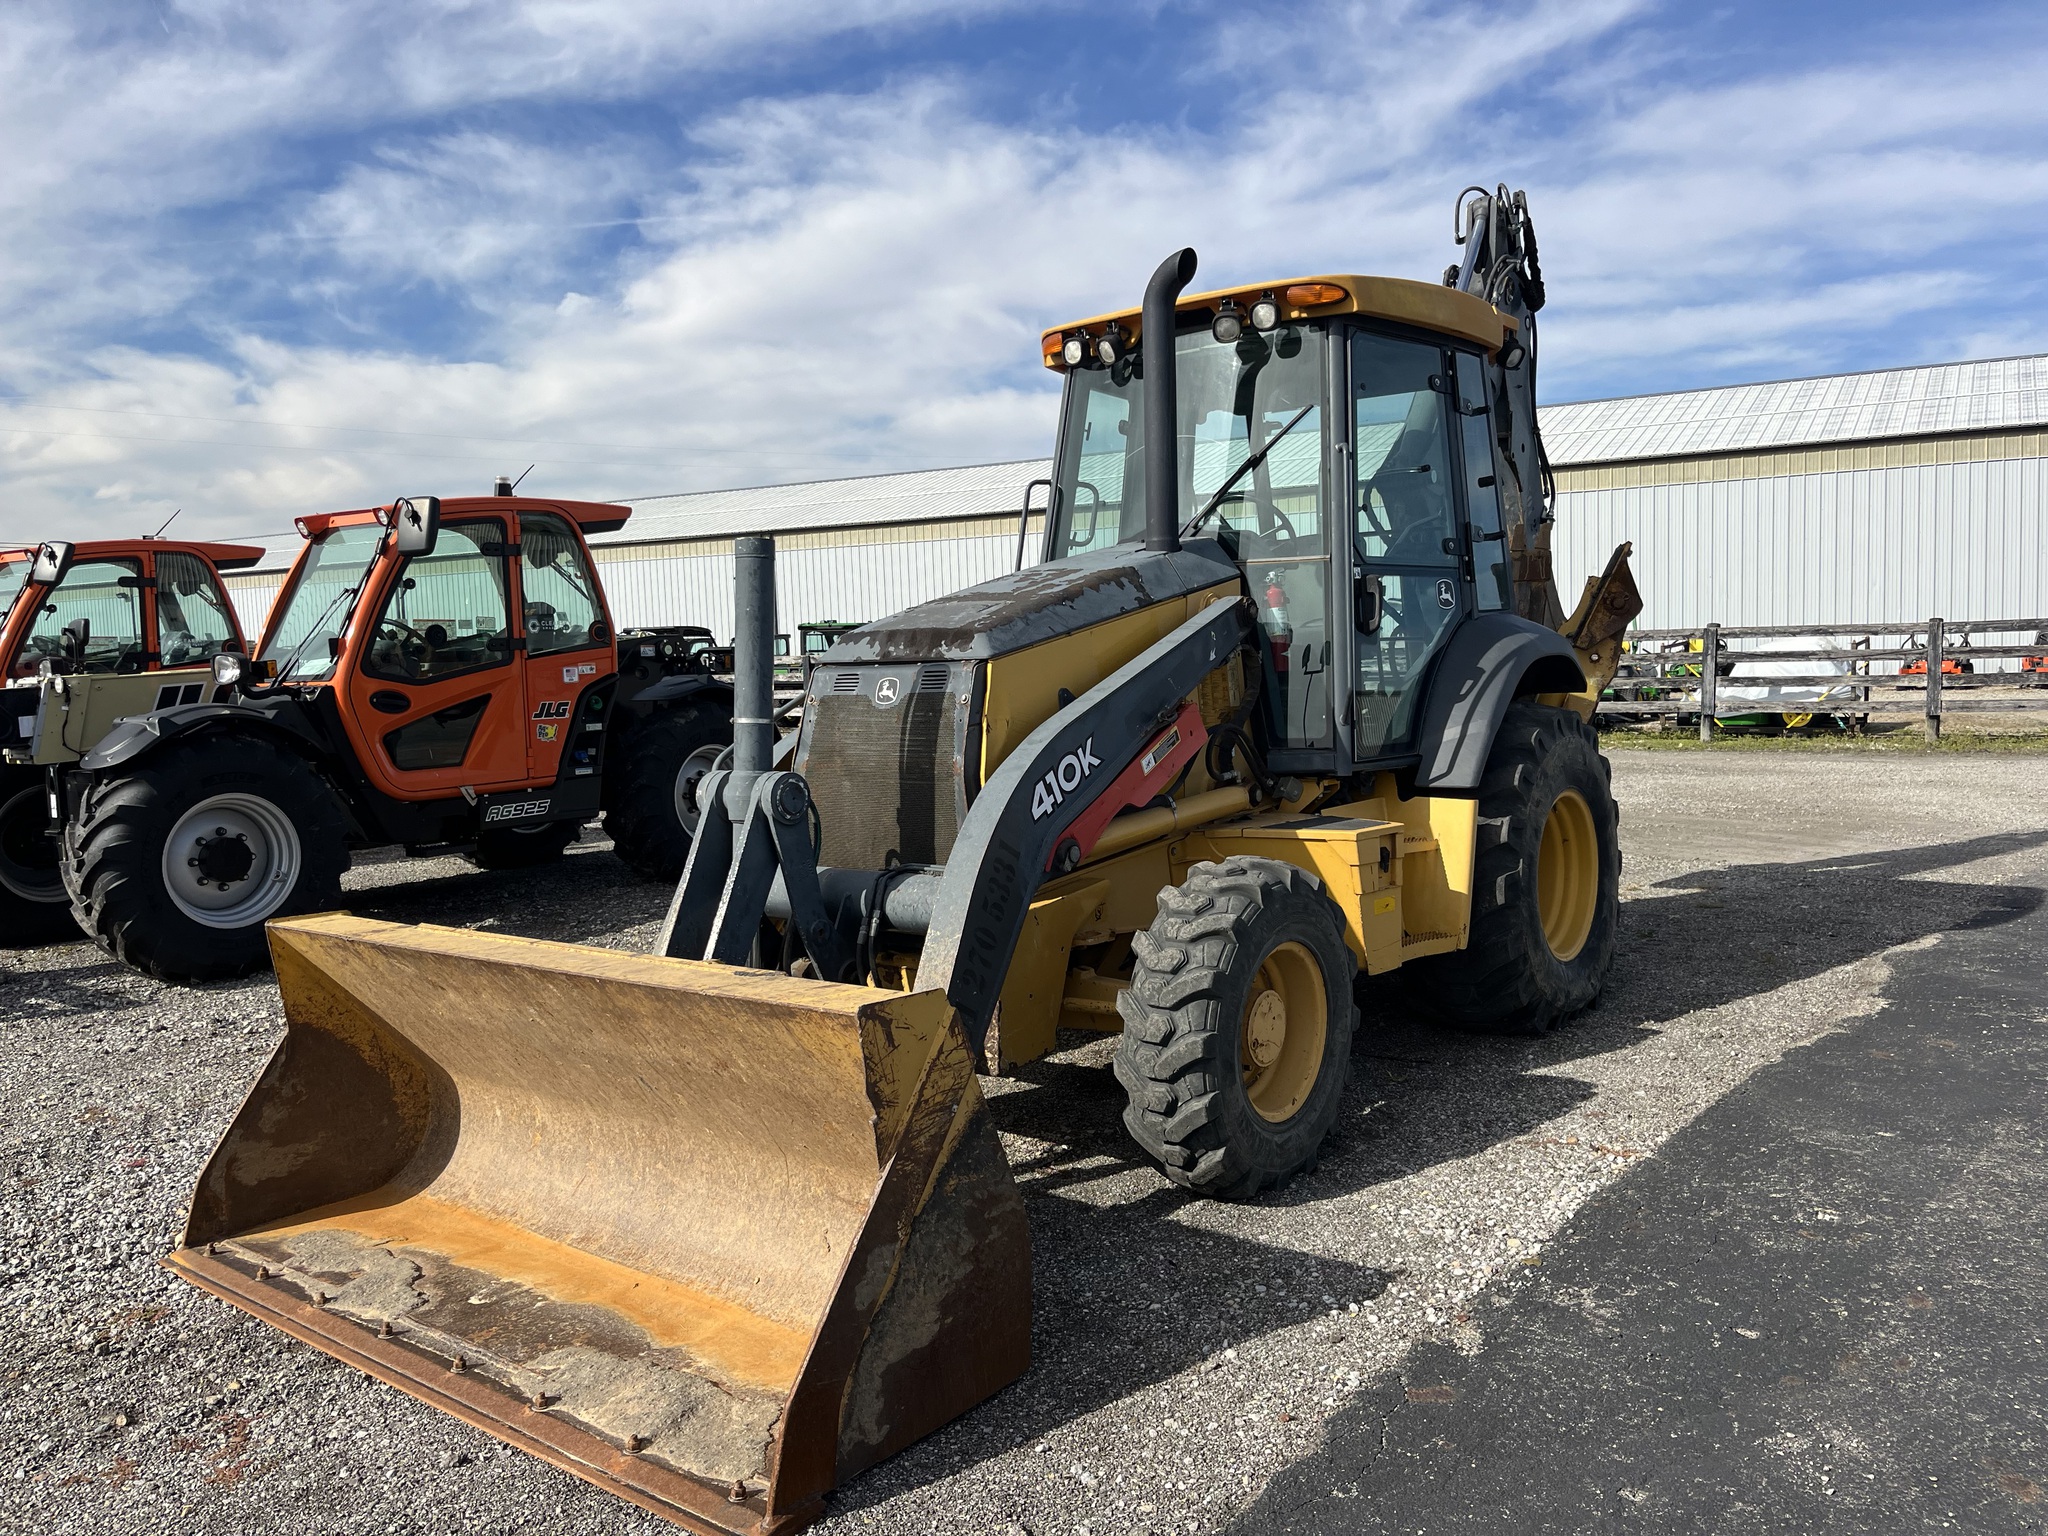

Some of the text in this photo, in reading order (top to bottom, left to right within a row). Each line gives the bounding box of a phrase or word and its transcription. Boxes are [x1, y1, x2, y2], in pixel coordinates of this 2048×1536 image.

[532, 701, 571, 719] JLG
[1030, 735, 1103, 822] 410K
[485, 799, 551, 822] AG925
